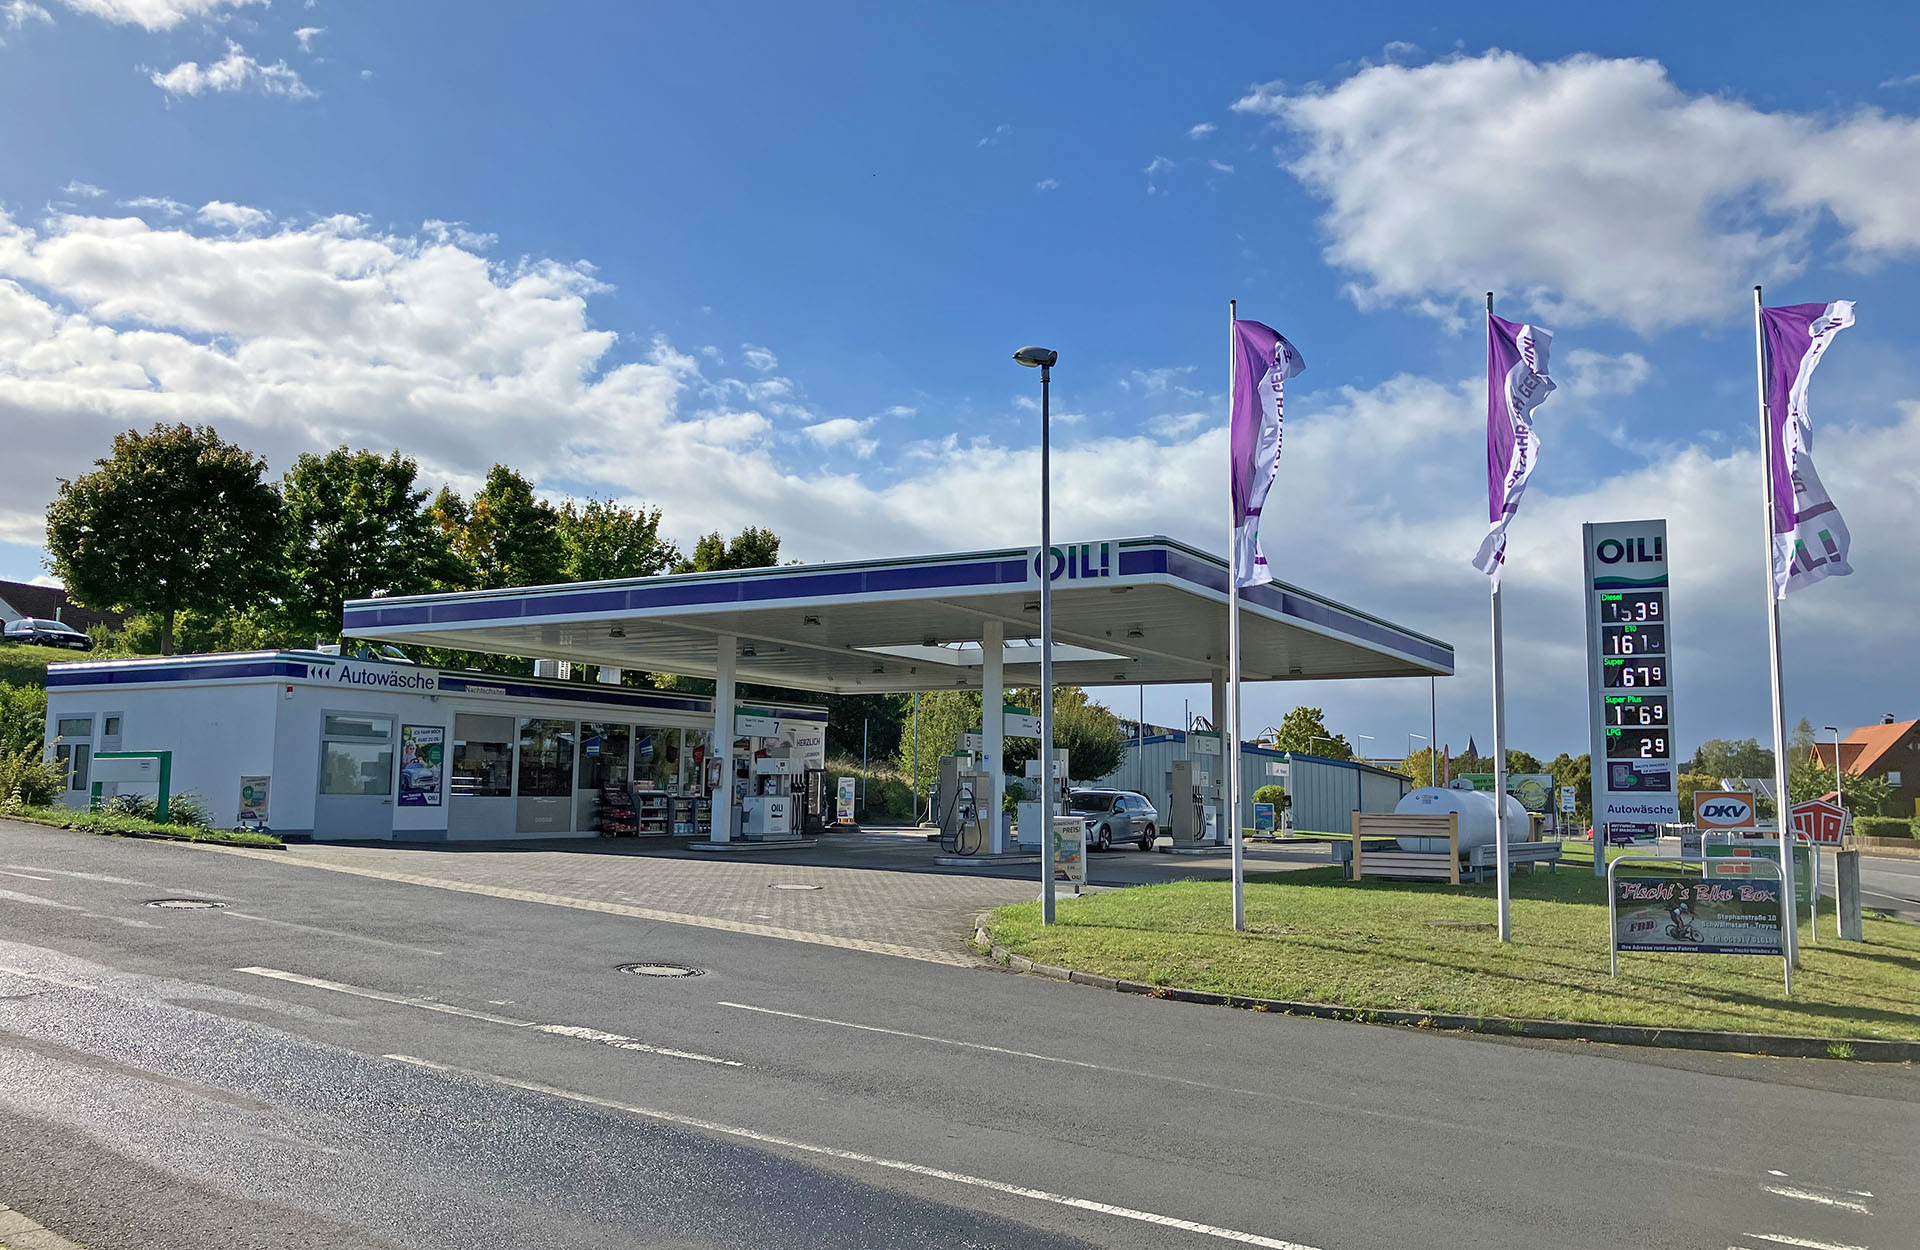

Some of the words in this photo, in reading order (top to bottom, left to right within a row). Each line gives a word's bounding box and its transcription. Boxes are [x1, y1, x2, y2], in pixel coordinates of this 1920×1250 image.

[1596, 536, 1663, 564] OIL!
[1034, 542, 1110, 581] OIL!
[1601, 593, 1622, 601] Diesel
[1624, 625, 1637, 633] E10
[1604, 658, 1624, 667] Super
[338, 665, 435, 690] Autowäsche
[1605, 696, 1626, 705] Super
[1627, 695, 1642, 703] Plus
[773, 721, 780, 735] 7
[1035, 720, 1042, 735] 3
[1606, 728, 1621, 736] LPG
[796, 737, 821, 746] HERZLICH
[966, 736, 971, 747] 5
[771, 803, 783, 812] OIL!
[1607, 804, 1674, 814] Autowäsche
[1702, 805, 1747, 818] DKV
[1693, 884, 1734, 901] Bike
[1737, 885, 1777, 903] Box
[1755, 922, 1777, 930] Treysa
